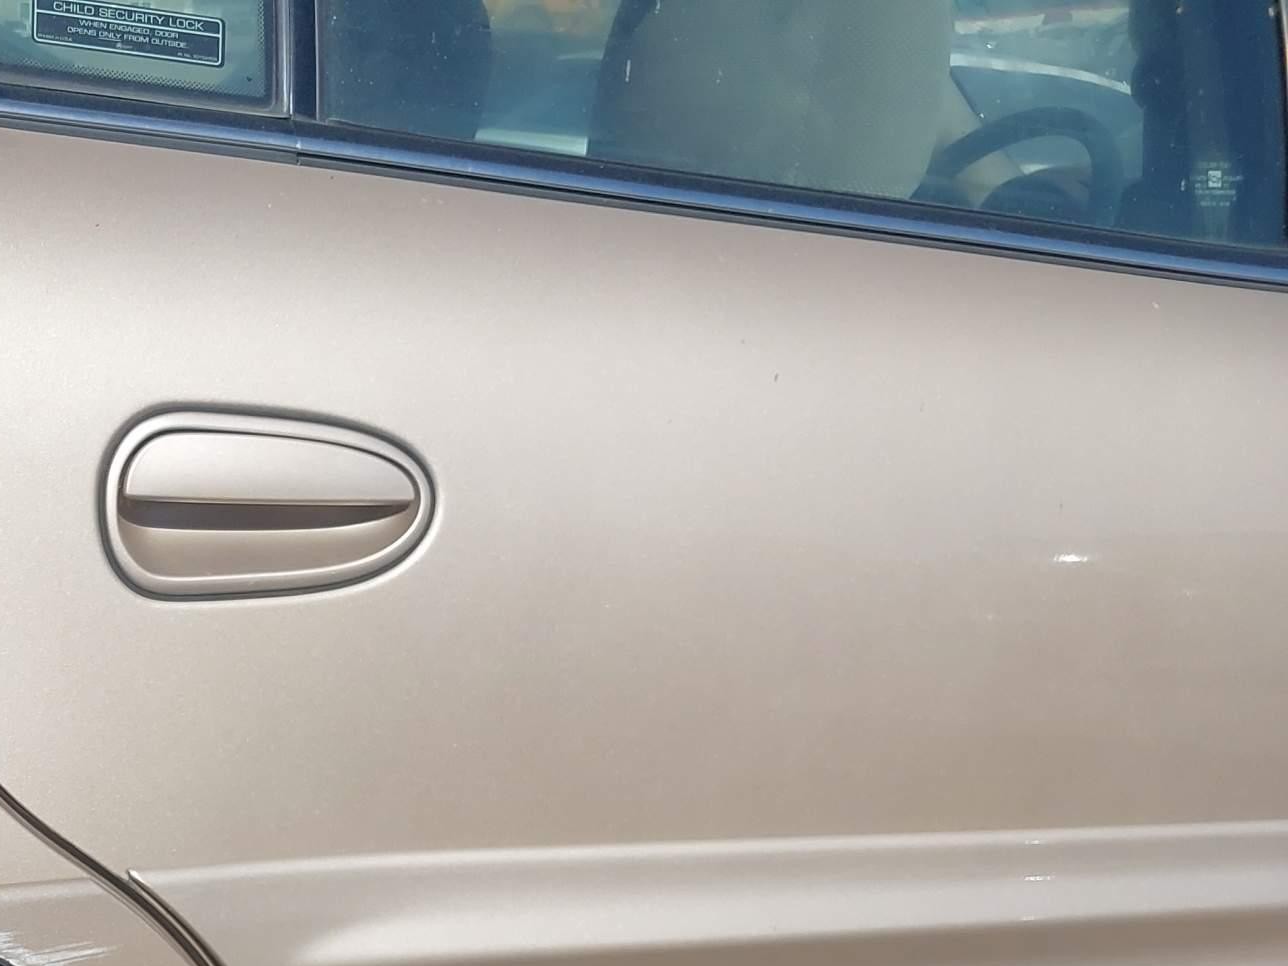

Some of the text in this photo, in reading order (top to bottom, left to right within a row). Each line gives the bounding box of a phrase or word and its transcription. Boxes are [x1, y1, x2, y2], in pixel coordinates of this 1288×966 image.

[53, 1, 204, 31] CHILD SECURITY LOCK
[67, 26, 97, 37] OPENS
[98, 30, 122, 41] ONLY
[123, 33, 150, 44] FROM
[79, 19, 107, 29] WHEN
[155, 30, 179, 40] DOOR
